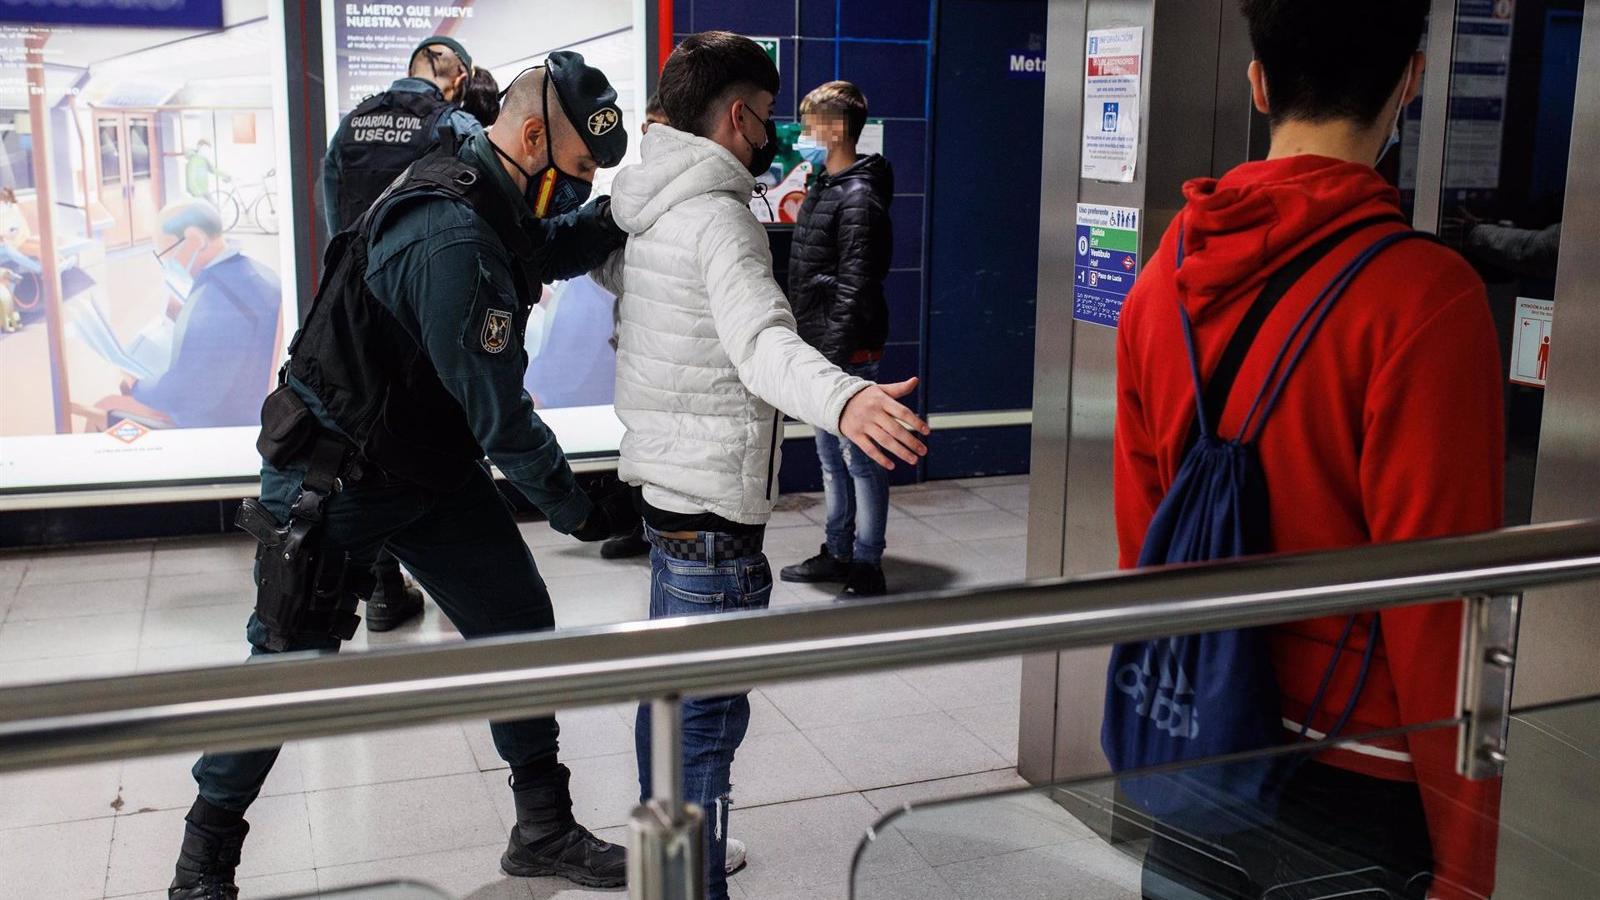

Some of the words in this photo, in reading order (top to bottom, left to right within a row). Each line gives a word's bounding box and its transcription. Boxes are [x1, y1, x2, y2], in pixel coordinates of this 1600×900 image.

[345, 4, 360, 15] EL
[363, 4, 403, 16] METRO
[406, 6, 430, 17] QUE
[434, 6, 473, 18] MUEVE
[346, 16, 401, 28] NUESTRA
[404, 17, 432, 28] VIDA
[351, 114, 394, 128] GUARDIA
[396, 116, 422, 130] CIVIL
[354, 128, 412, 143] USECIC
[1088, 208, 1108, 216] preferente
[1091, 227, 1105, 236] Salida
